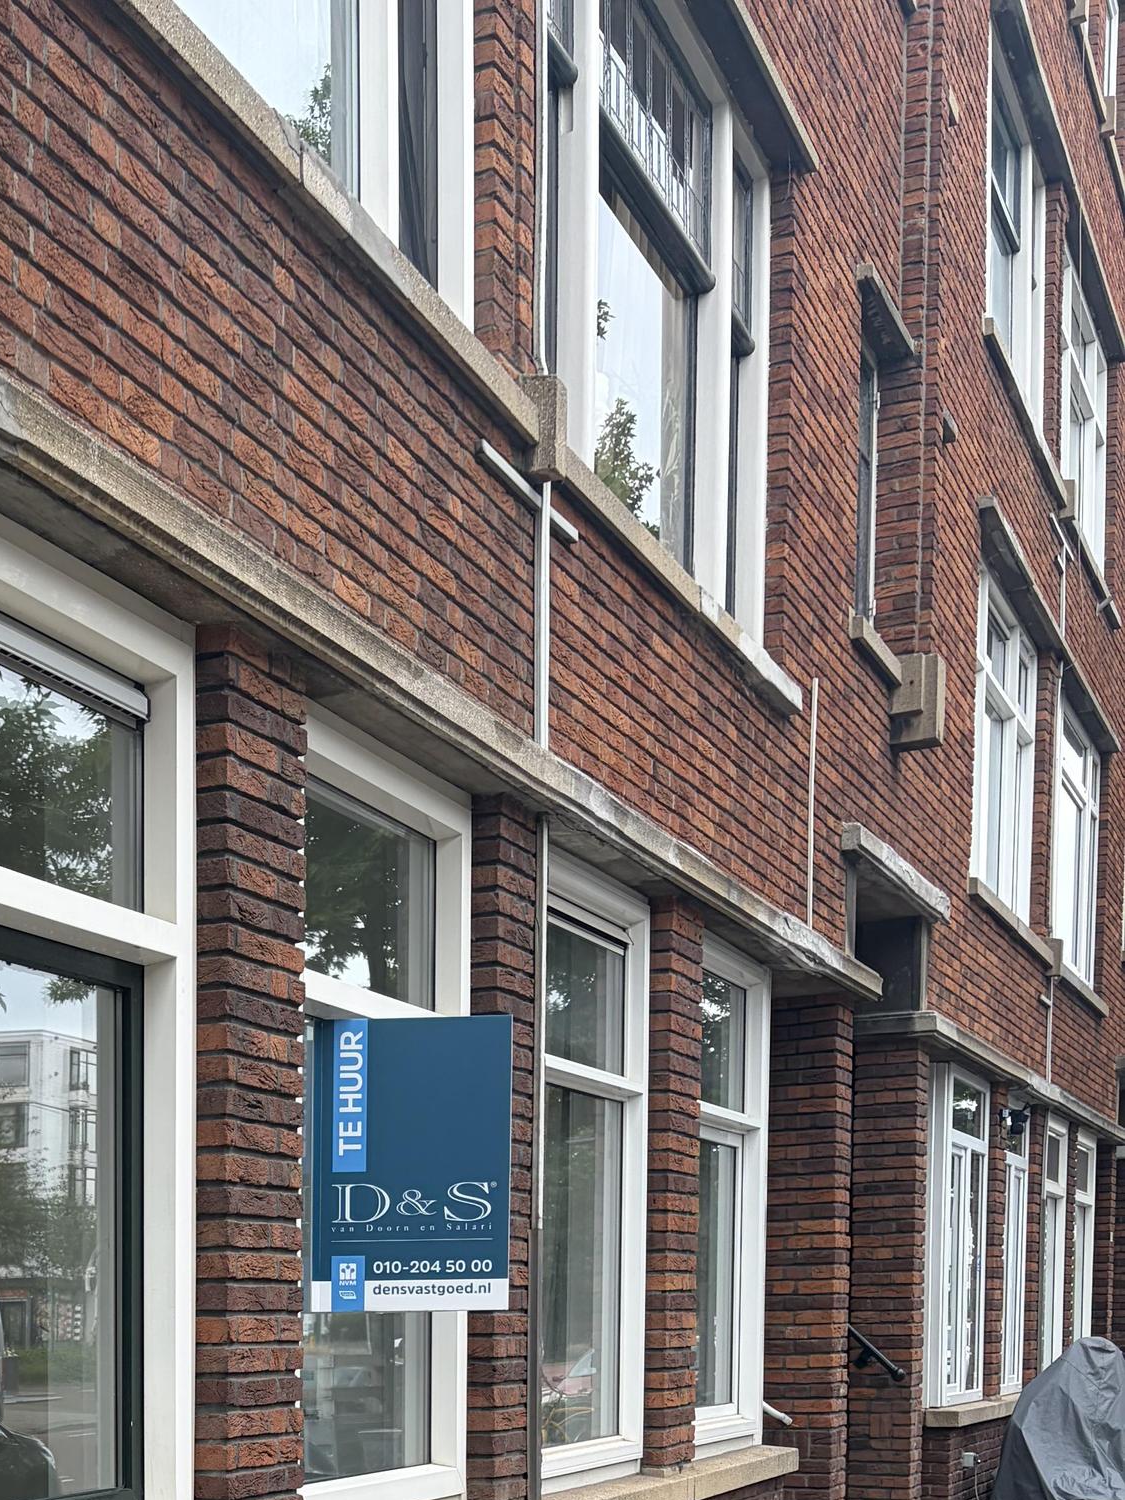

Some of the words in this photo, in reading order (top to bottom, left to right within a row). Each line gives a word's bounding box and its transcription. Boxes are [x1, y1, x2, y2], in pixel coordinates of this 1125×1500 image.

[339, 1031, 364, 1113] HUUR
[338, 1120, 363, 1156] TE
[365, 1224, 410, 1232] Doorn
[446, 1222, 493, 1231] Salari
[372, 1260, 442, 1274] 010-204
[445, 1259, 466, 1273] 50
[471, 1259, 493, 1272] 00
[372, 1282, 492, 1296] densvastgoed.nl
